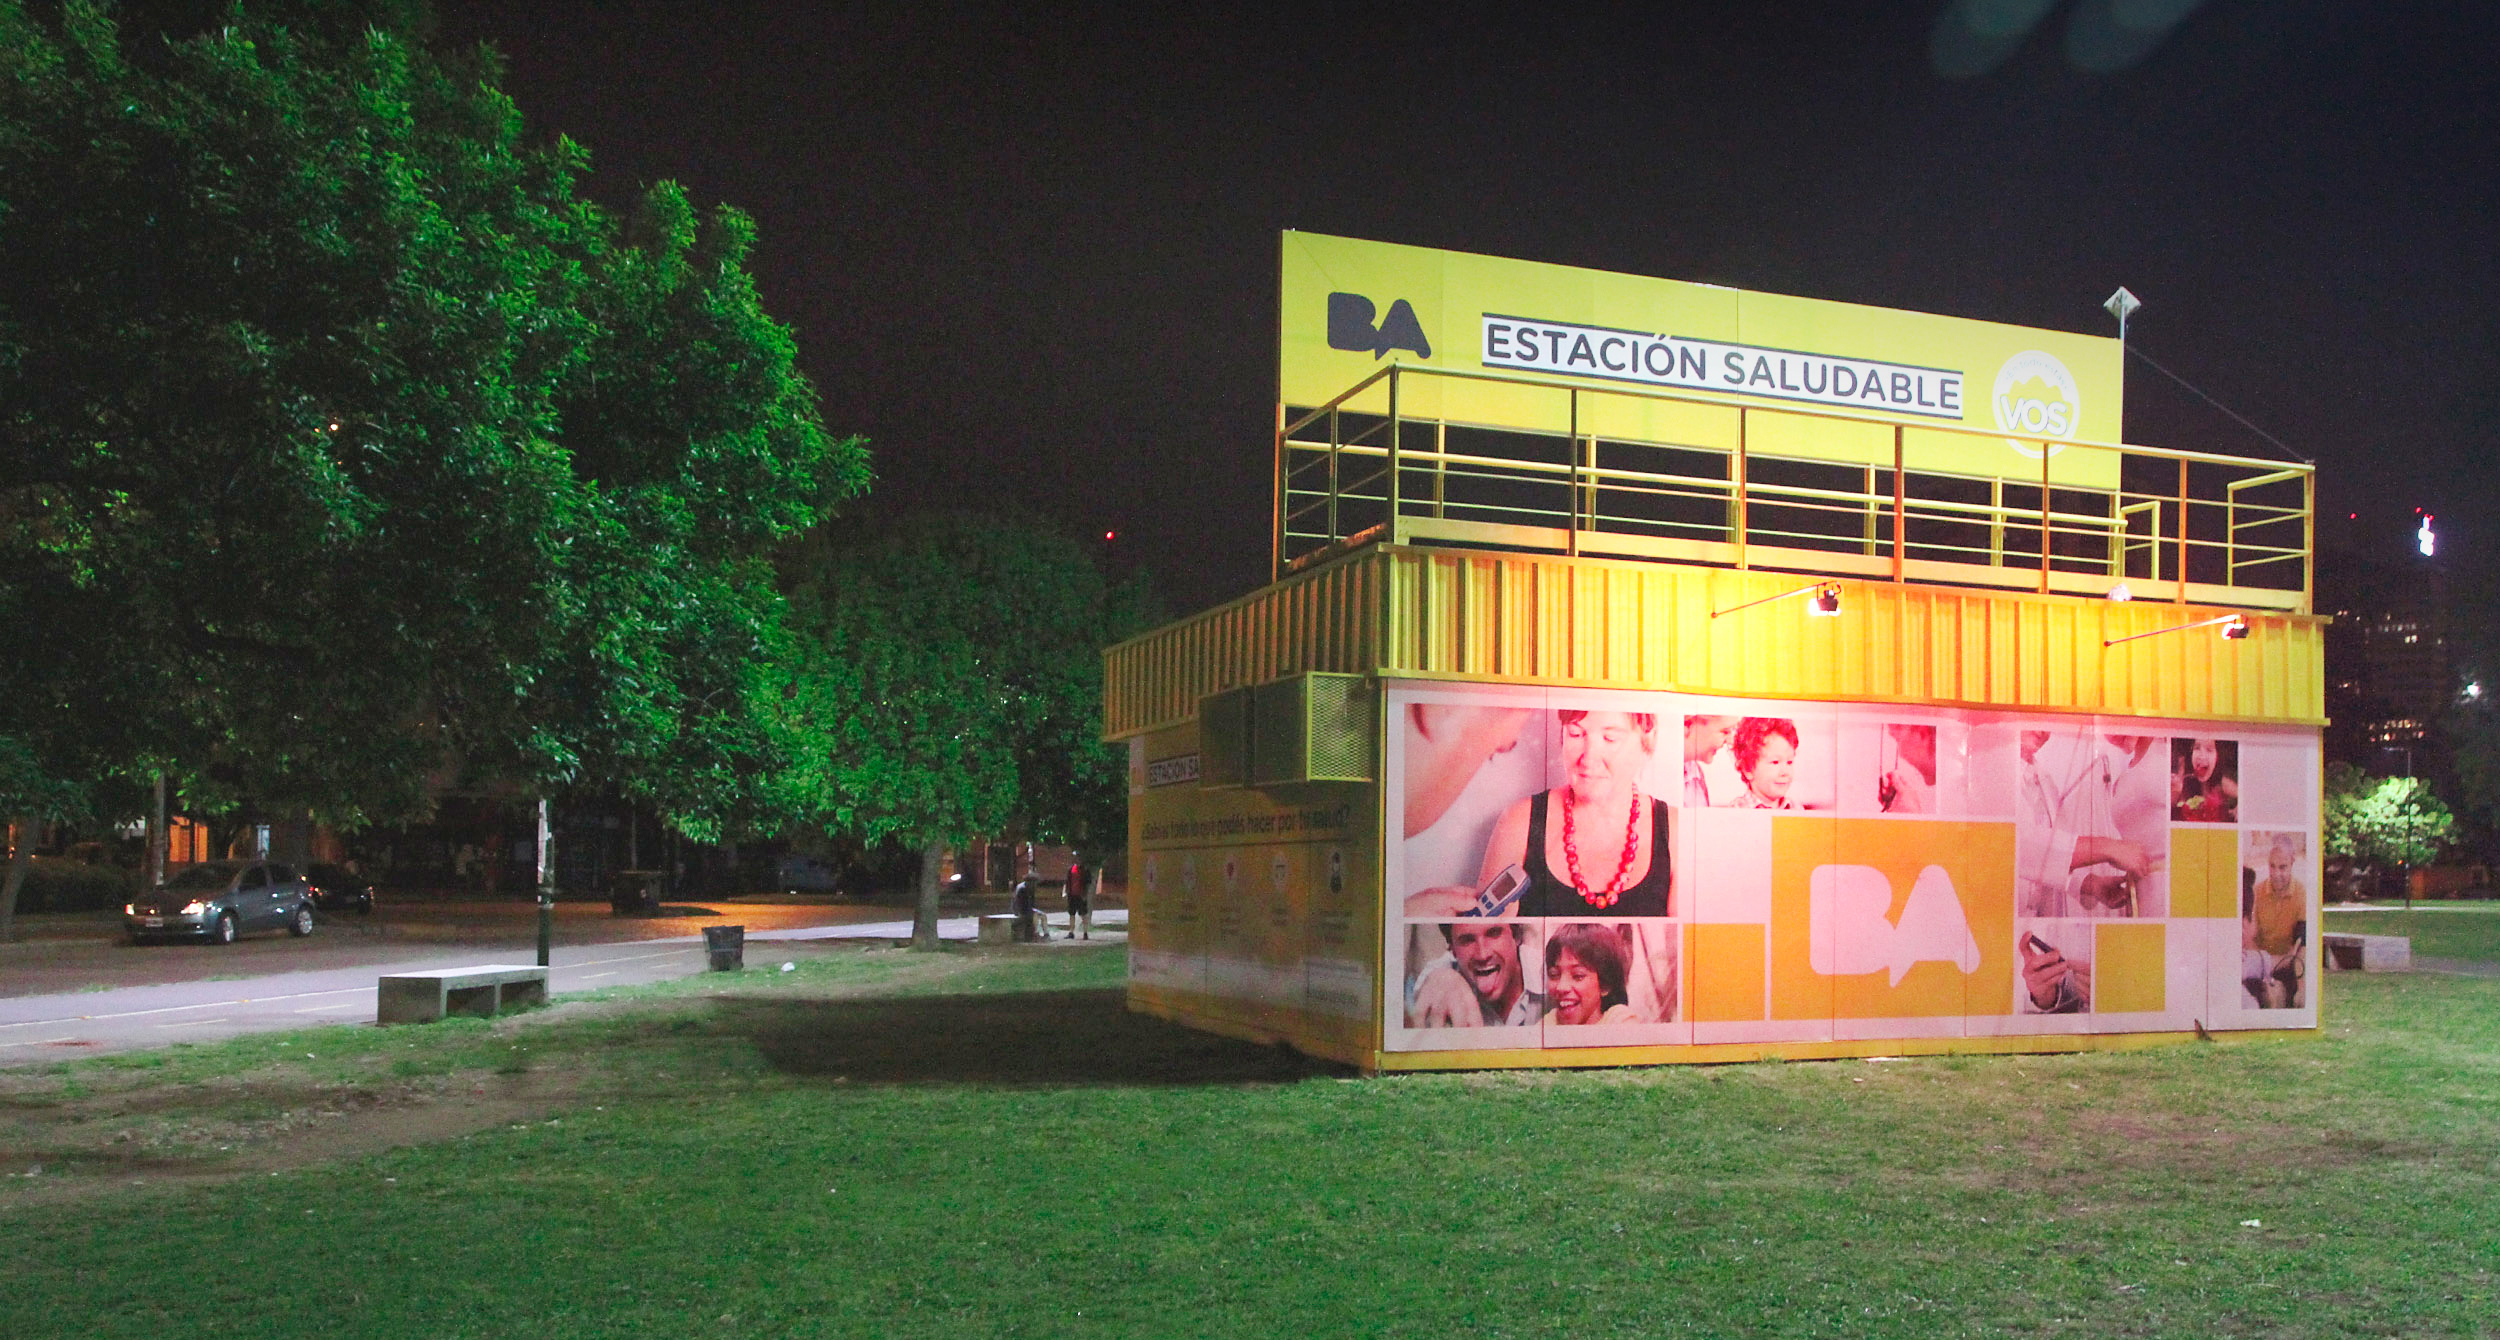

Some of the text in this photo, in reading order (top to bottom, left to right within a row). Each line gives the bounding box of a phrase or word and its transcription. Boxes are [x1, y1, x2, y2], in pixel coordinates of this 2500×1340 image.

[1328, 292, 1432, 361] BA
[1487, 323, 1960, 410] ESTACIÓN SALUDABLE
[1999, 394, 2069, 436] VOS
[1809, 863, 1981, 988] BA
